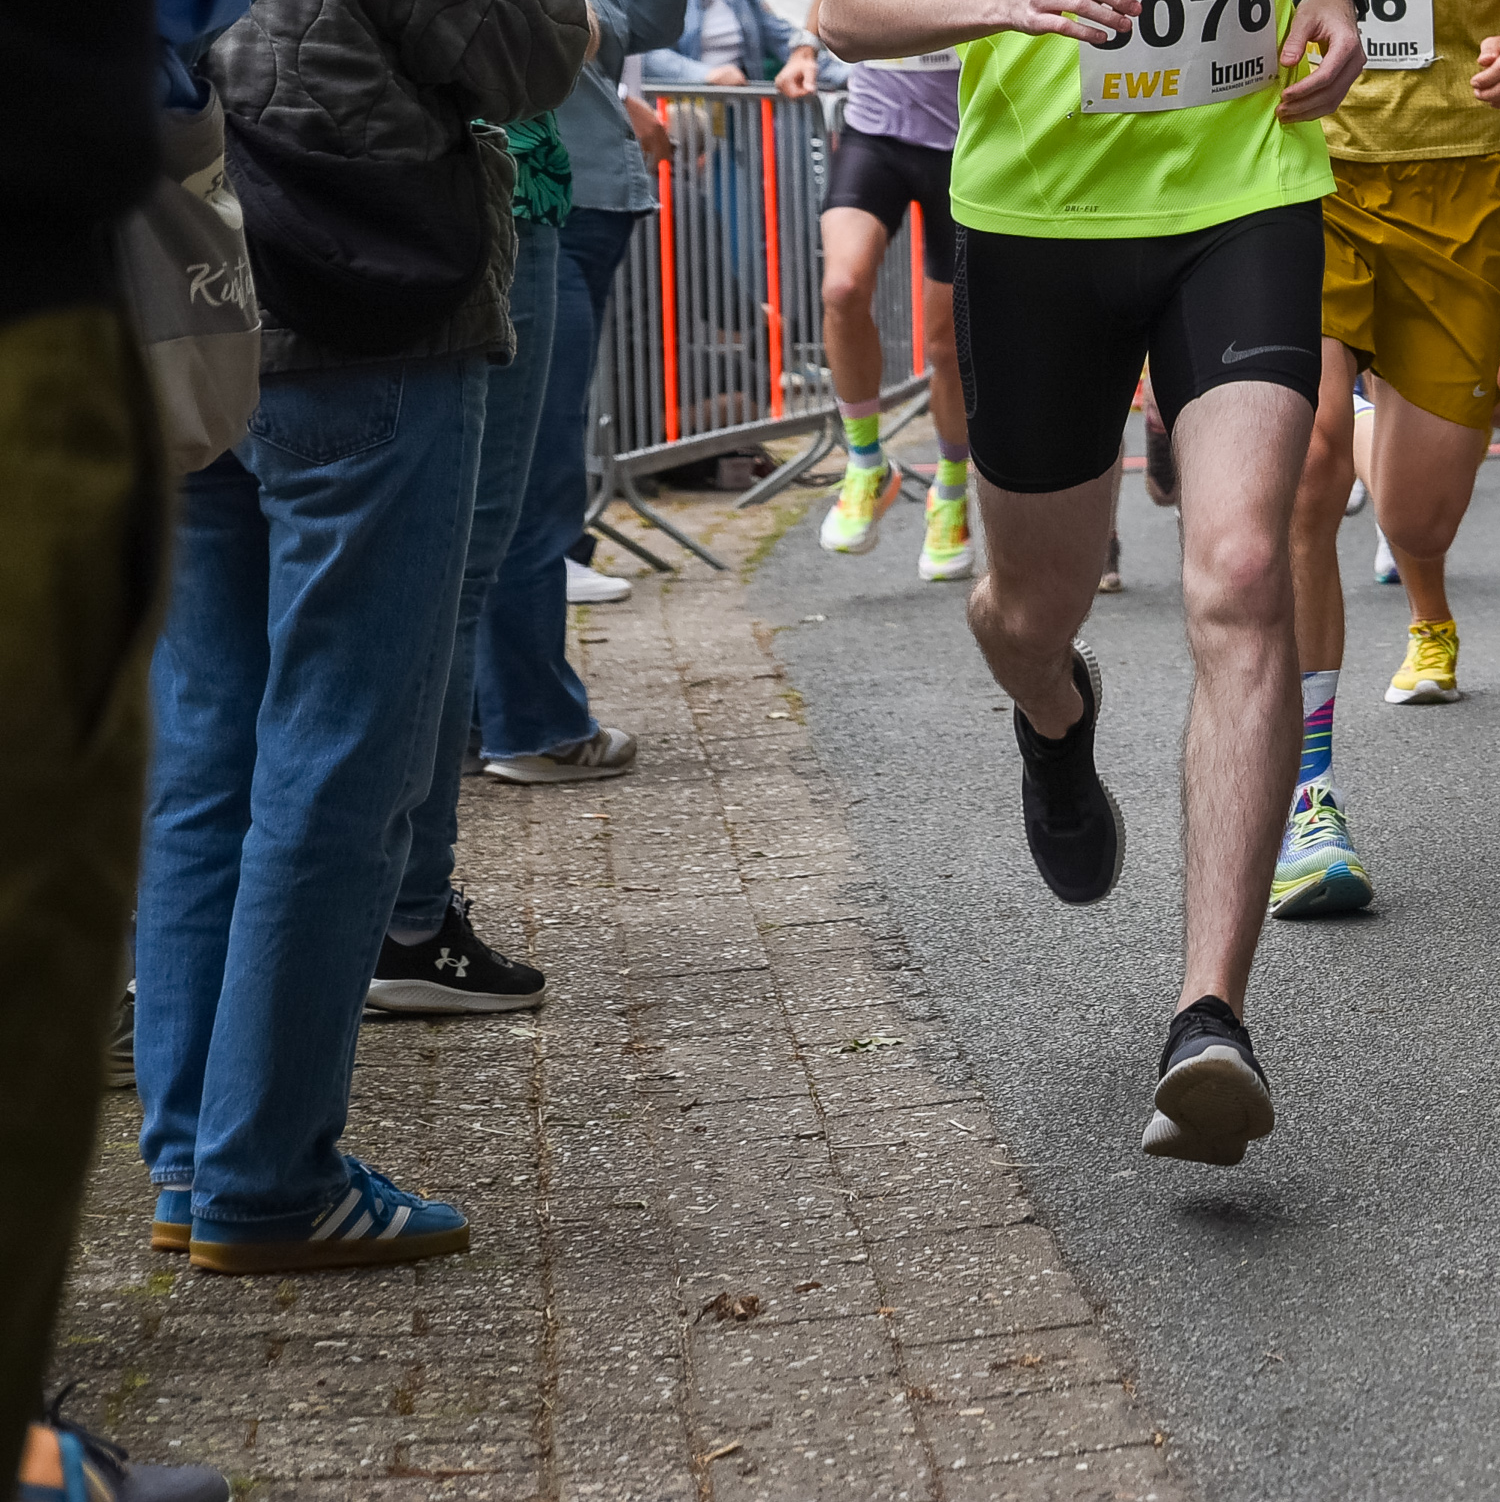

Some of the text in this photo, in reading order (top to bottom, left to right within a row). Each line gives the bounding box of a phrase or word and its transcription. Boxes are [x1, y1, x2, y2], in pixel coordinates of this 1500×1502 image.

[1367, 38, 1419, 57] bruns
[1102, 69, 1181, 100] EWE
[1211, 56, 1264, 86] bruns
